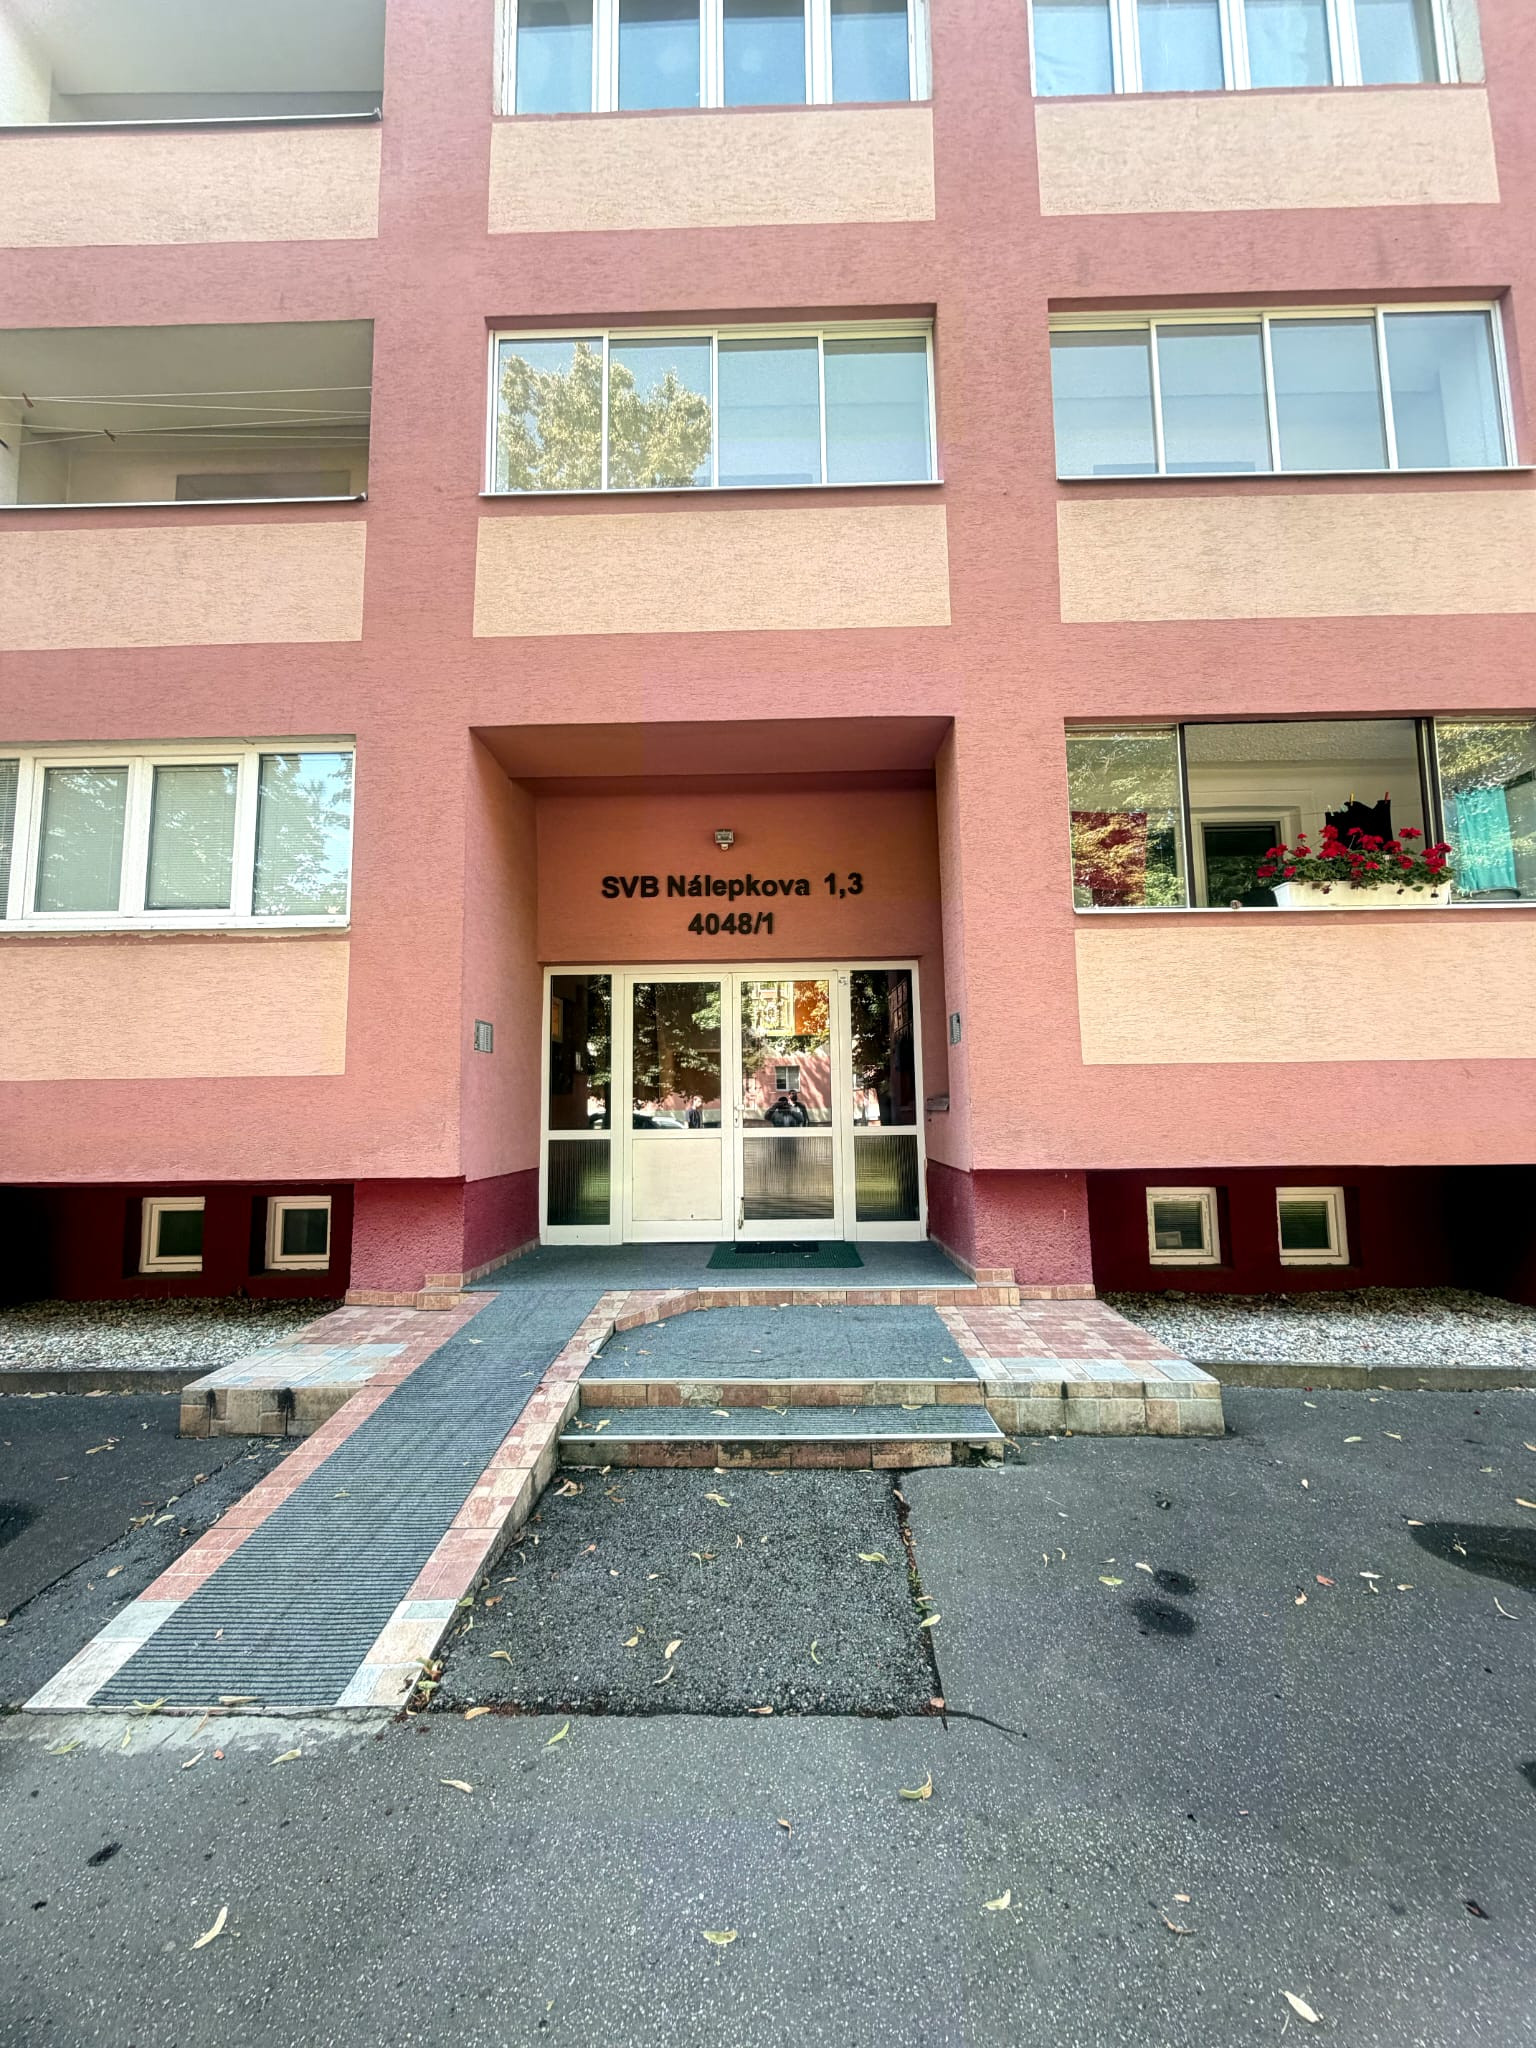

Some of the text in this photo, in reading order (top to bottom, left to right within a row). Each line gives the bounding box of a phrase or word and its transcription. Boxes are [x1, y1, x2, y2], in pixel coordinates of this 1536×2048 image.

[601, 872, 865, 902] SVB Nálepkova 1,3
[688, 912, 774, 935] 4048/1
